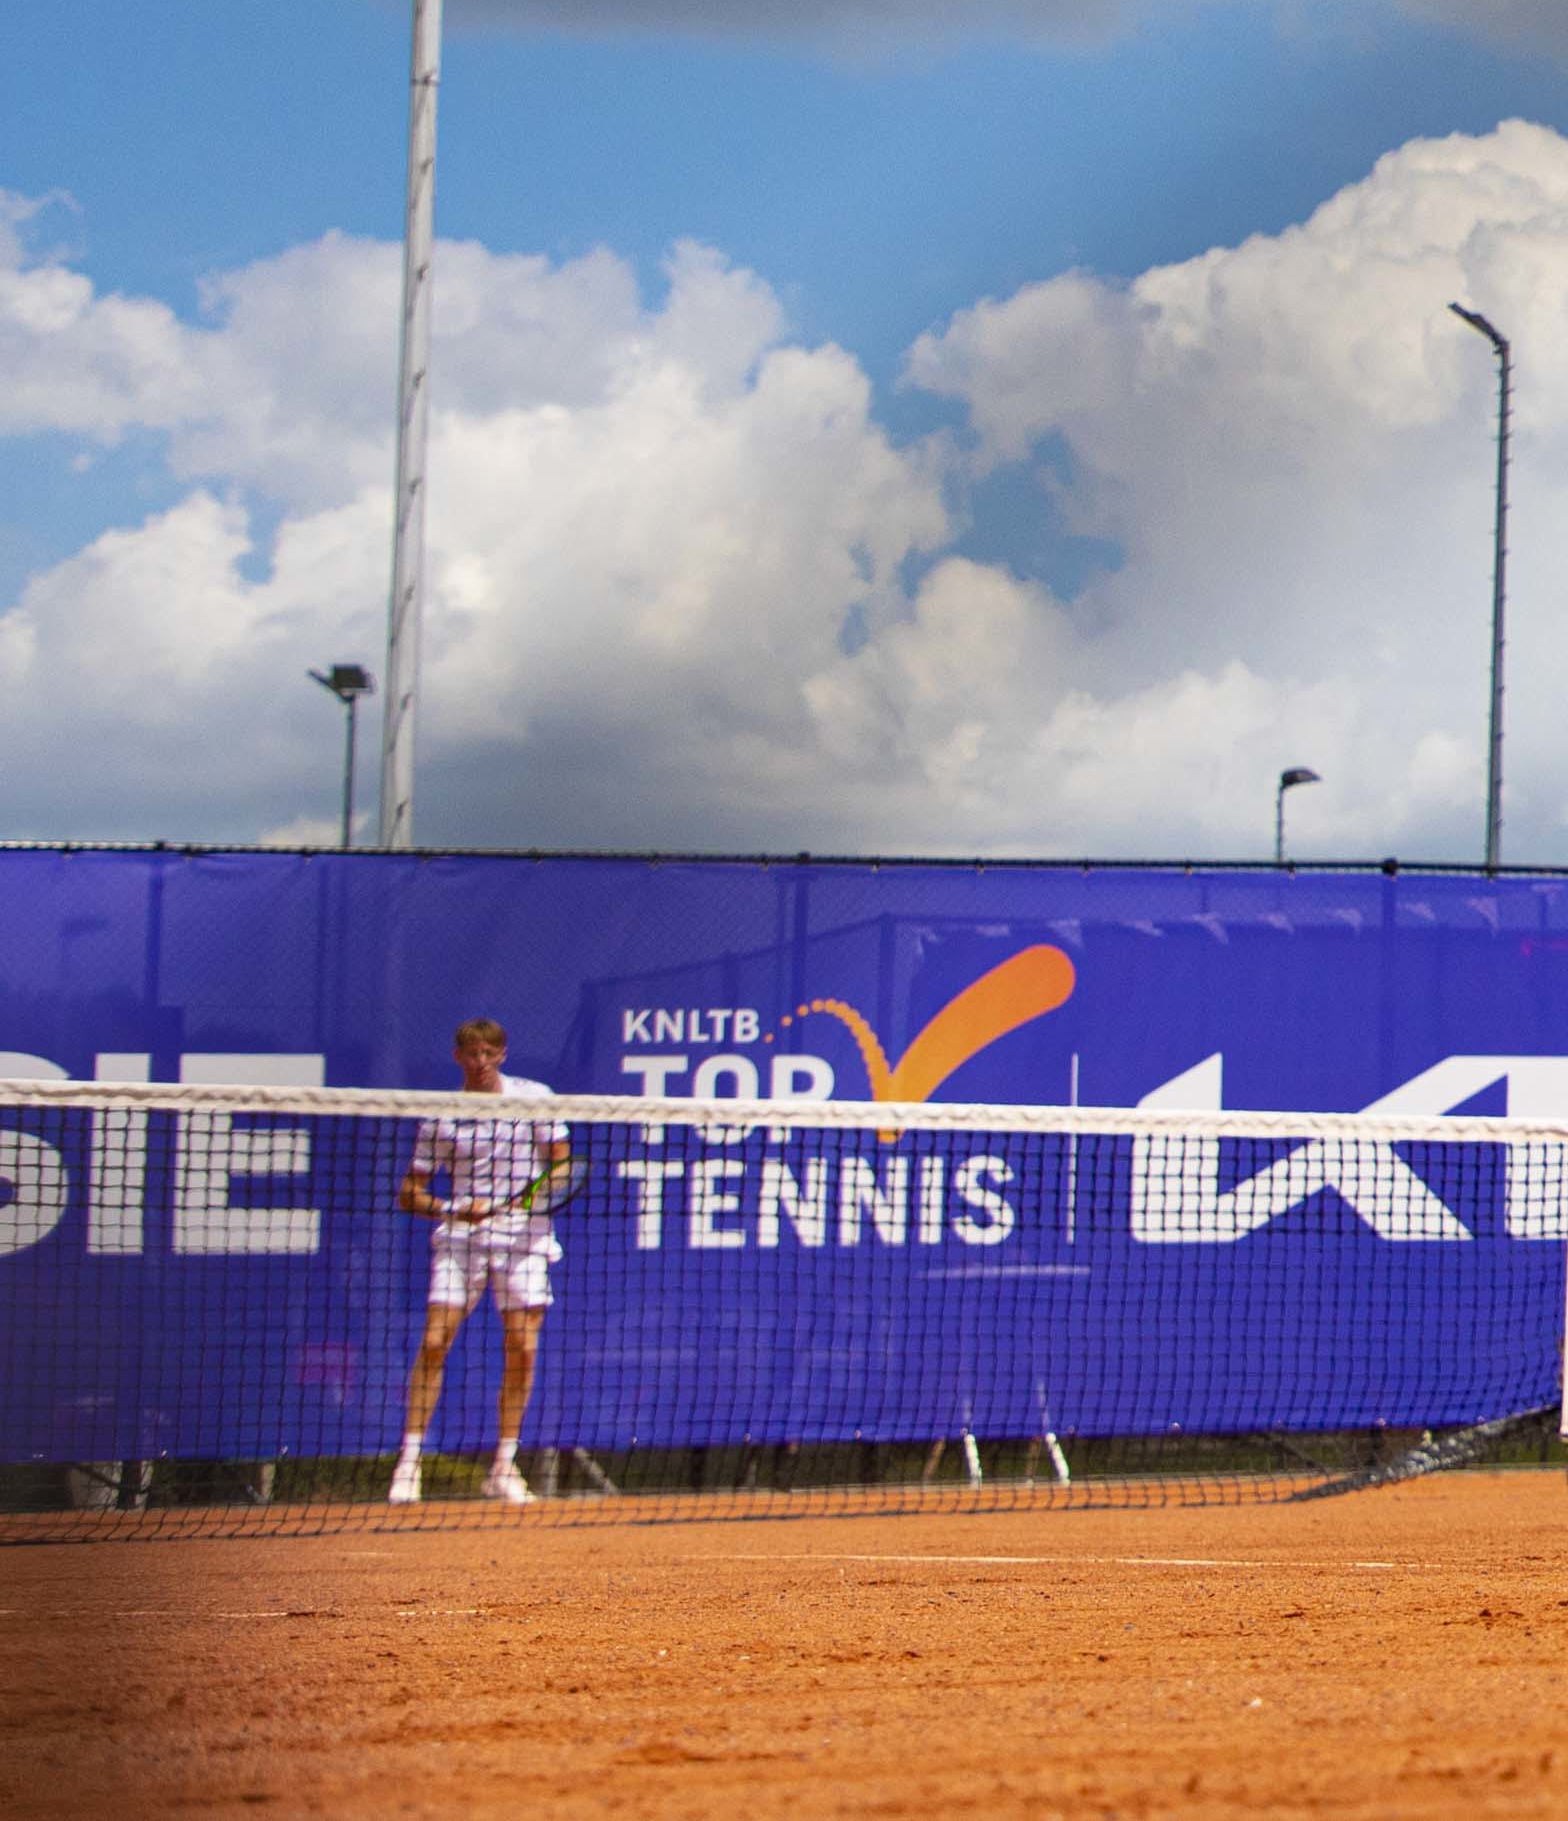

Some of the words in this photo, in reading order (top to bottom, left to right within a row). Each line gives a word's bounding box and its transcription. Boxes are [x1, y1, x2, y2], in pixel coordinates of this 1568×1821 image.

[623, 1009, 760, 1045] KNLTB
[622, 1055, 836, 1143] TOP
[620, 1156, 1016, 1249] TENNIS
